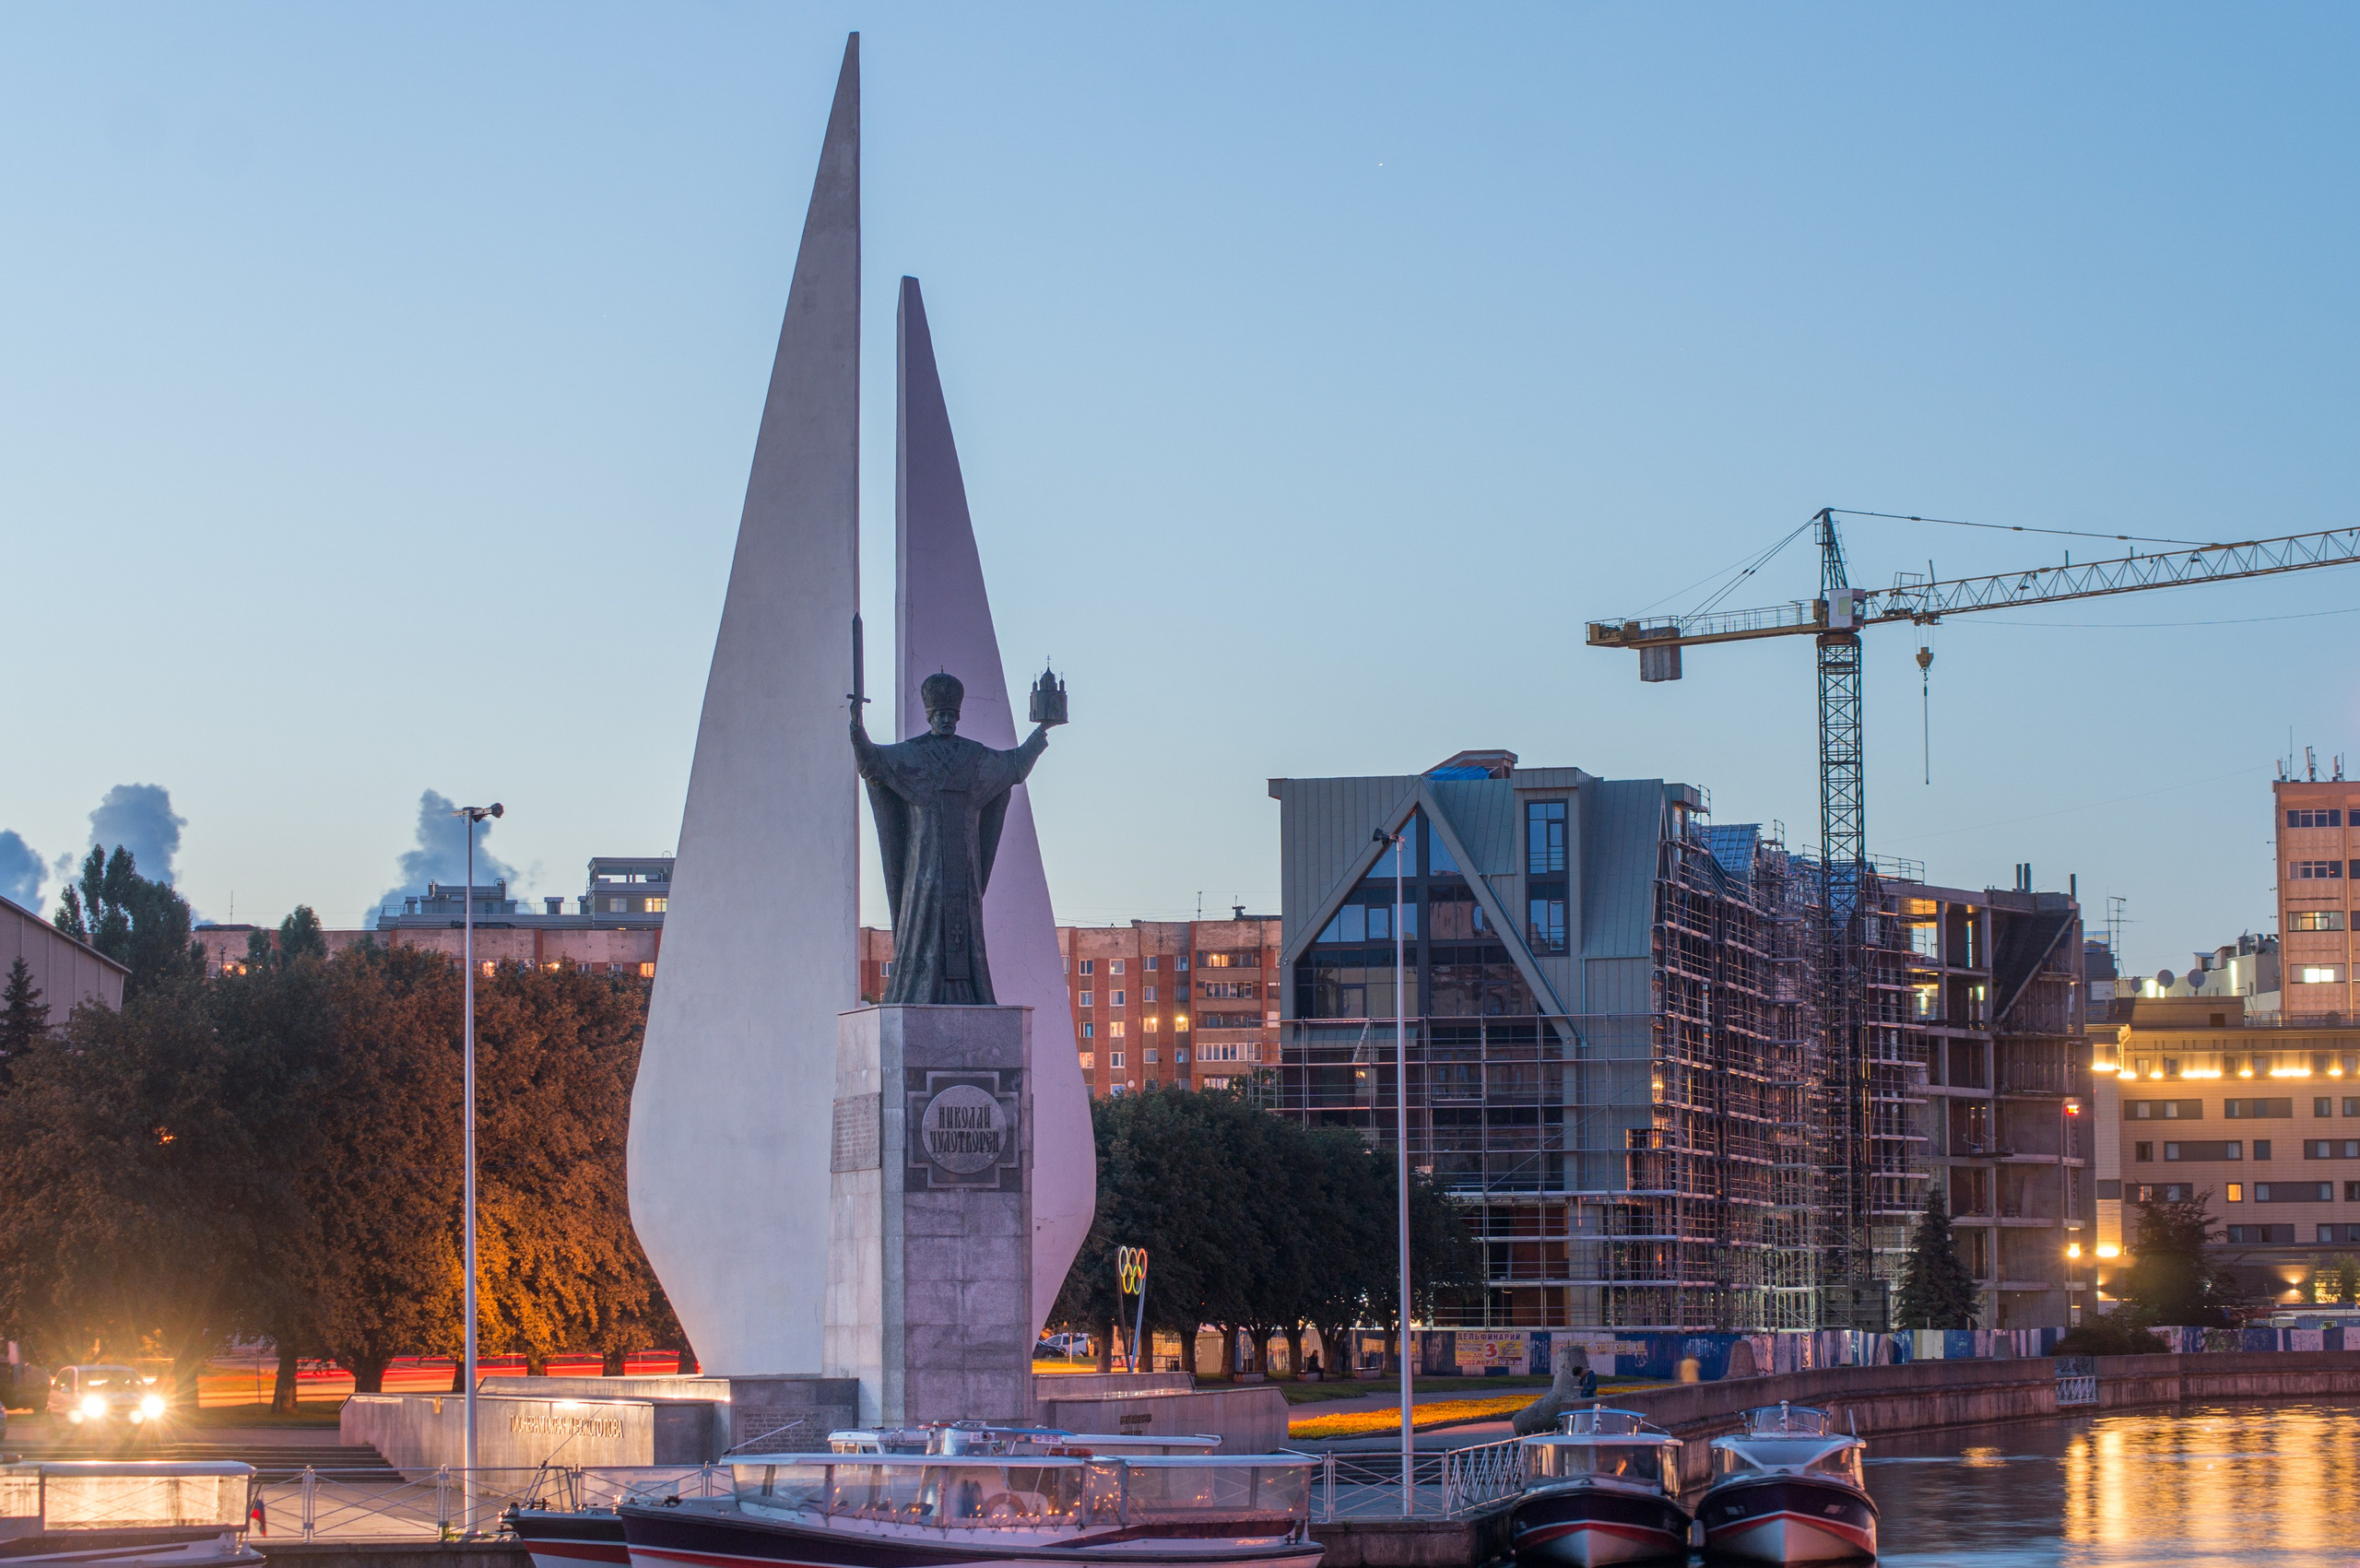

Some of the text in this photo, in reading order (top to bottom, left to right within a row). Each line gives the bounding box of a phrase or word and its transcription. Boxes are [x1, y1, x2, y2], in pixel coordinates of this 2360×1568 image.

[938, 1104, 991, 1129] НИКОЛАЙ
[930, 1131, 1000, 1153] ЧУДОТВОРЕЦ
[1457, 1332, 1521, 1341] ДЕЛЬФИНАРИЙ
[1484, 1342, 1498, 1358] 3
[604, 1419, 624, 1438] ЛОВА
